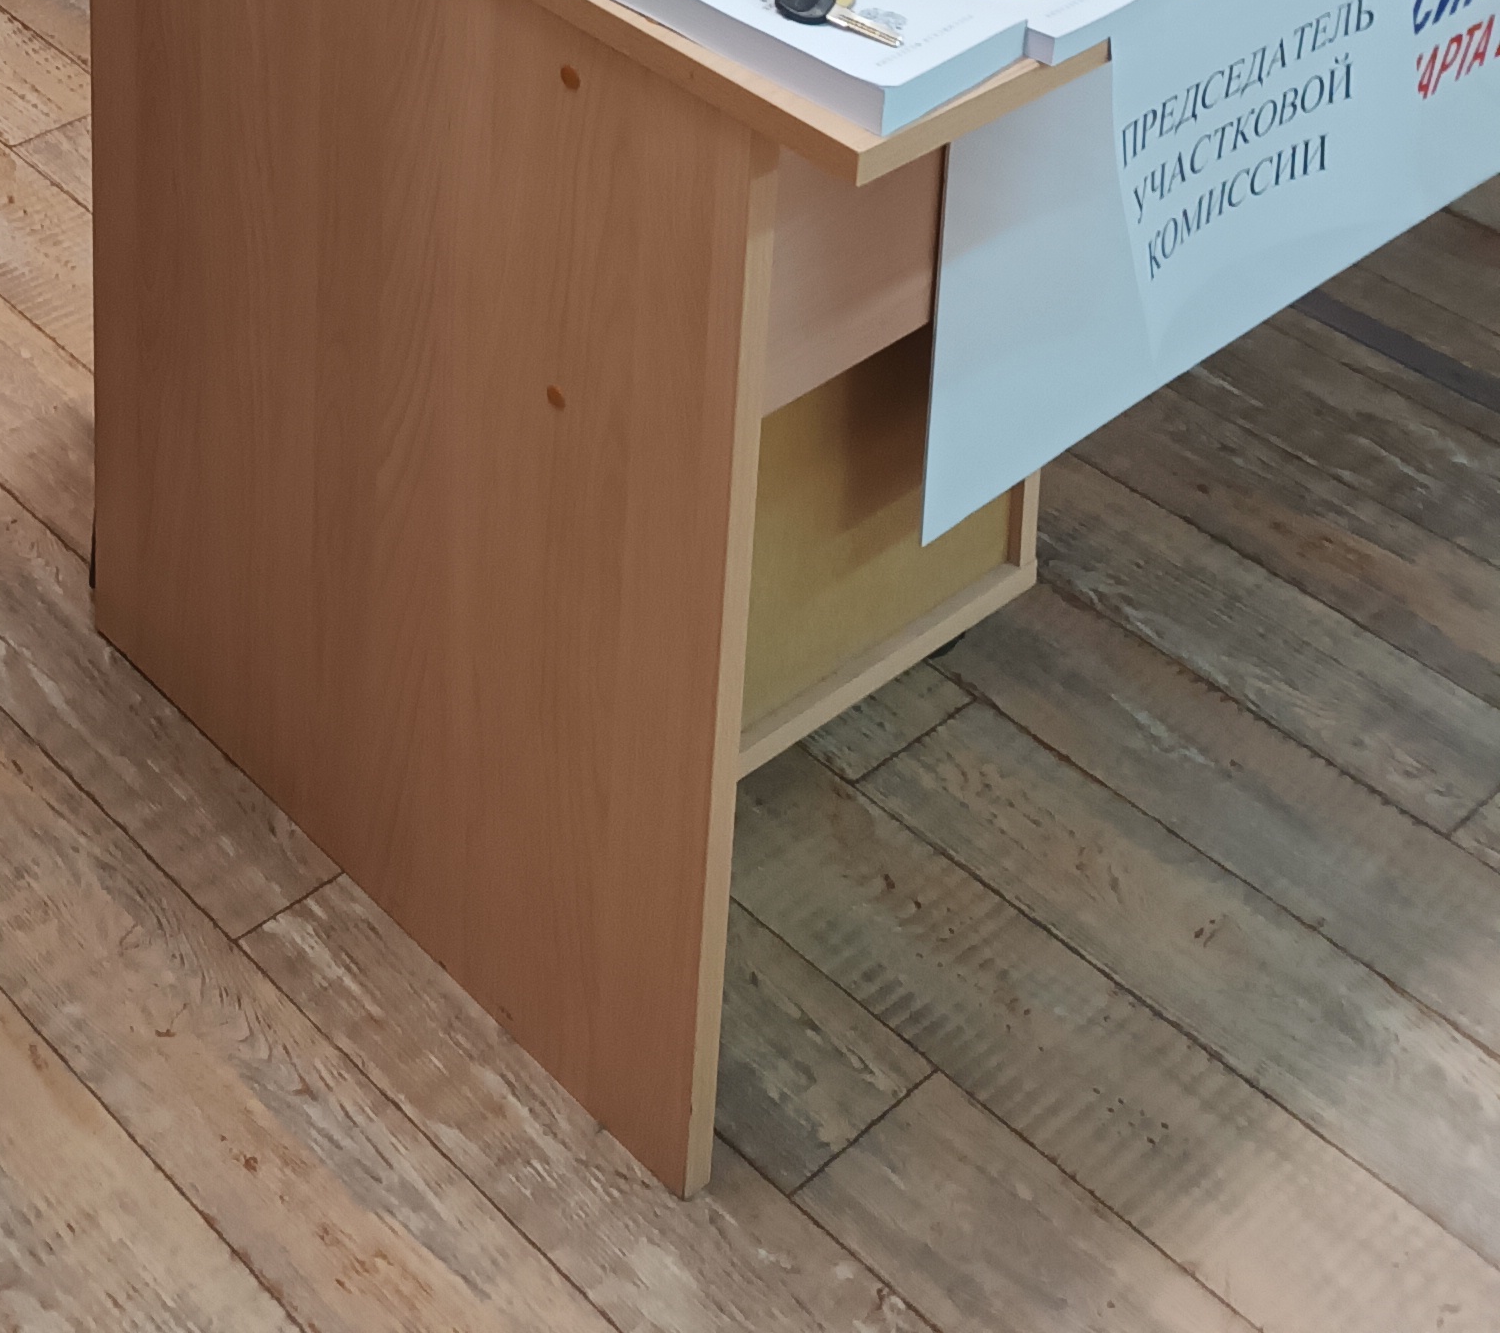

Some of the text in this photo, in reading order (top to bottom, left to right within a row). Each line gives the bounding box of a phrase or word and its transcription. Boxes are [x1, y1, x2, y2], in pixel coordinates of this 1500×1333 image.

[1416, 13, 1495, 101] АРТА
[1133, 52, 1352, 224] УЧАСТКОВОЙ
[1148, 134, 1329, 281] КОМИССИИ
